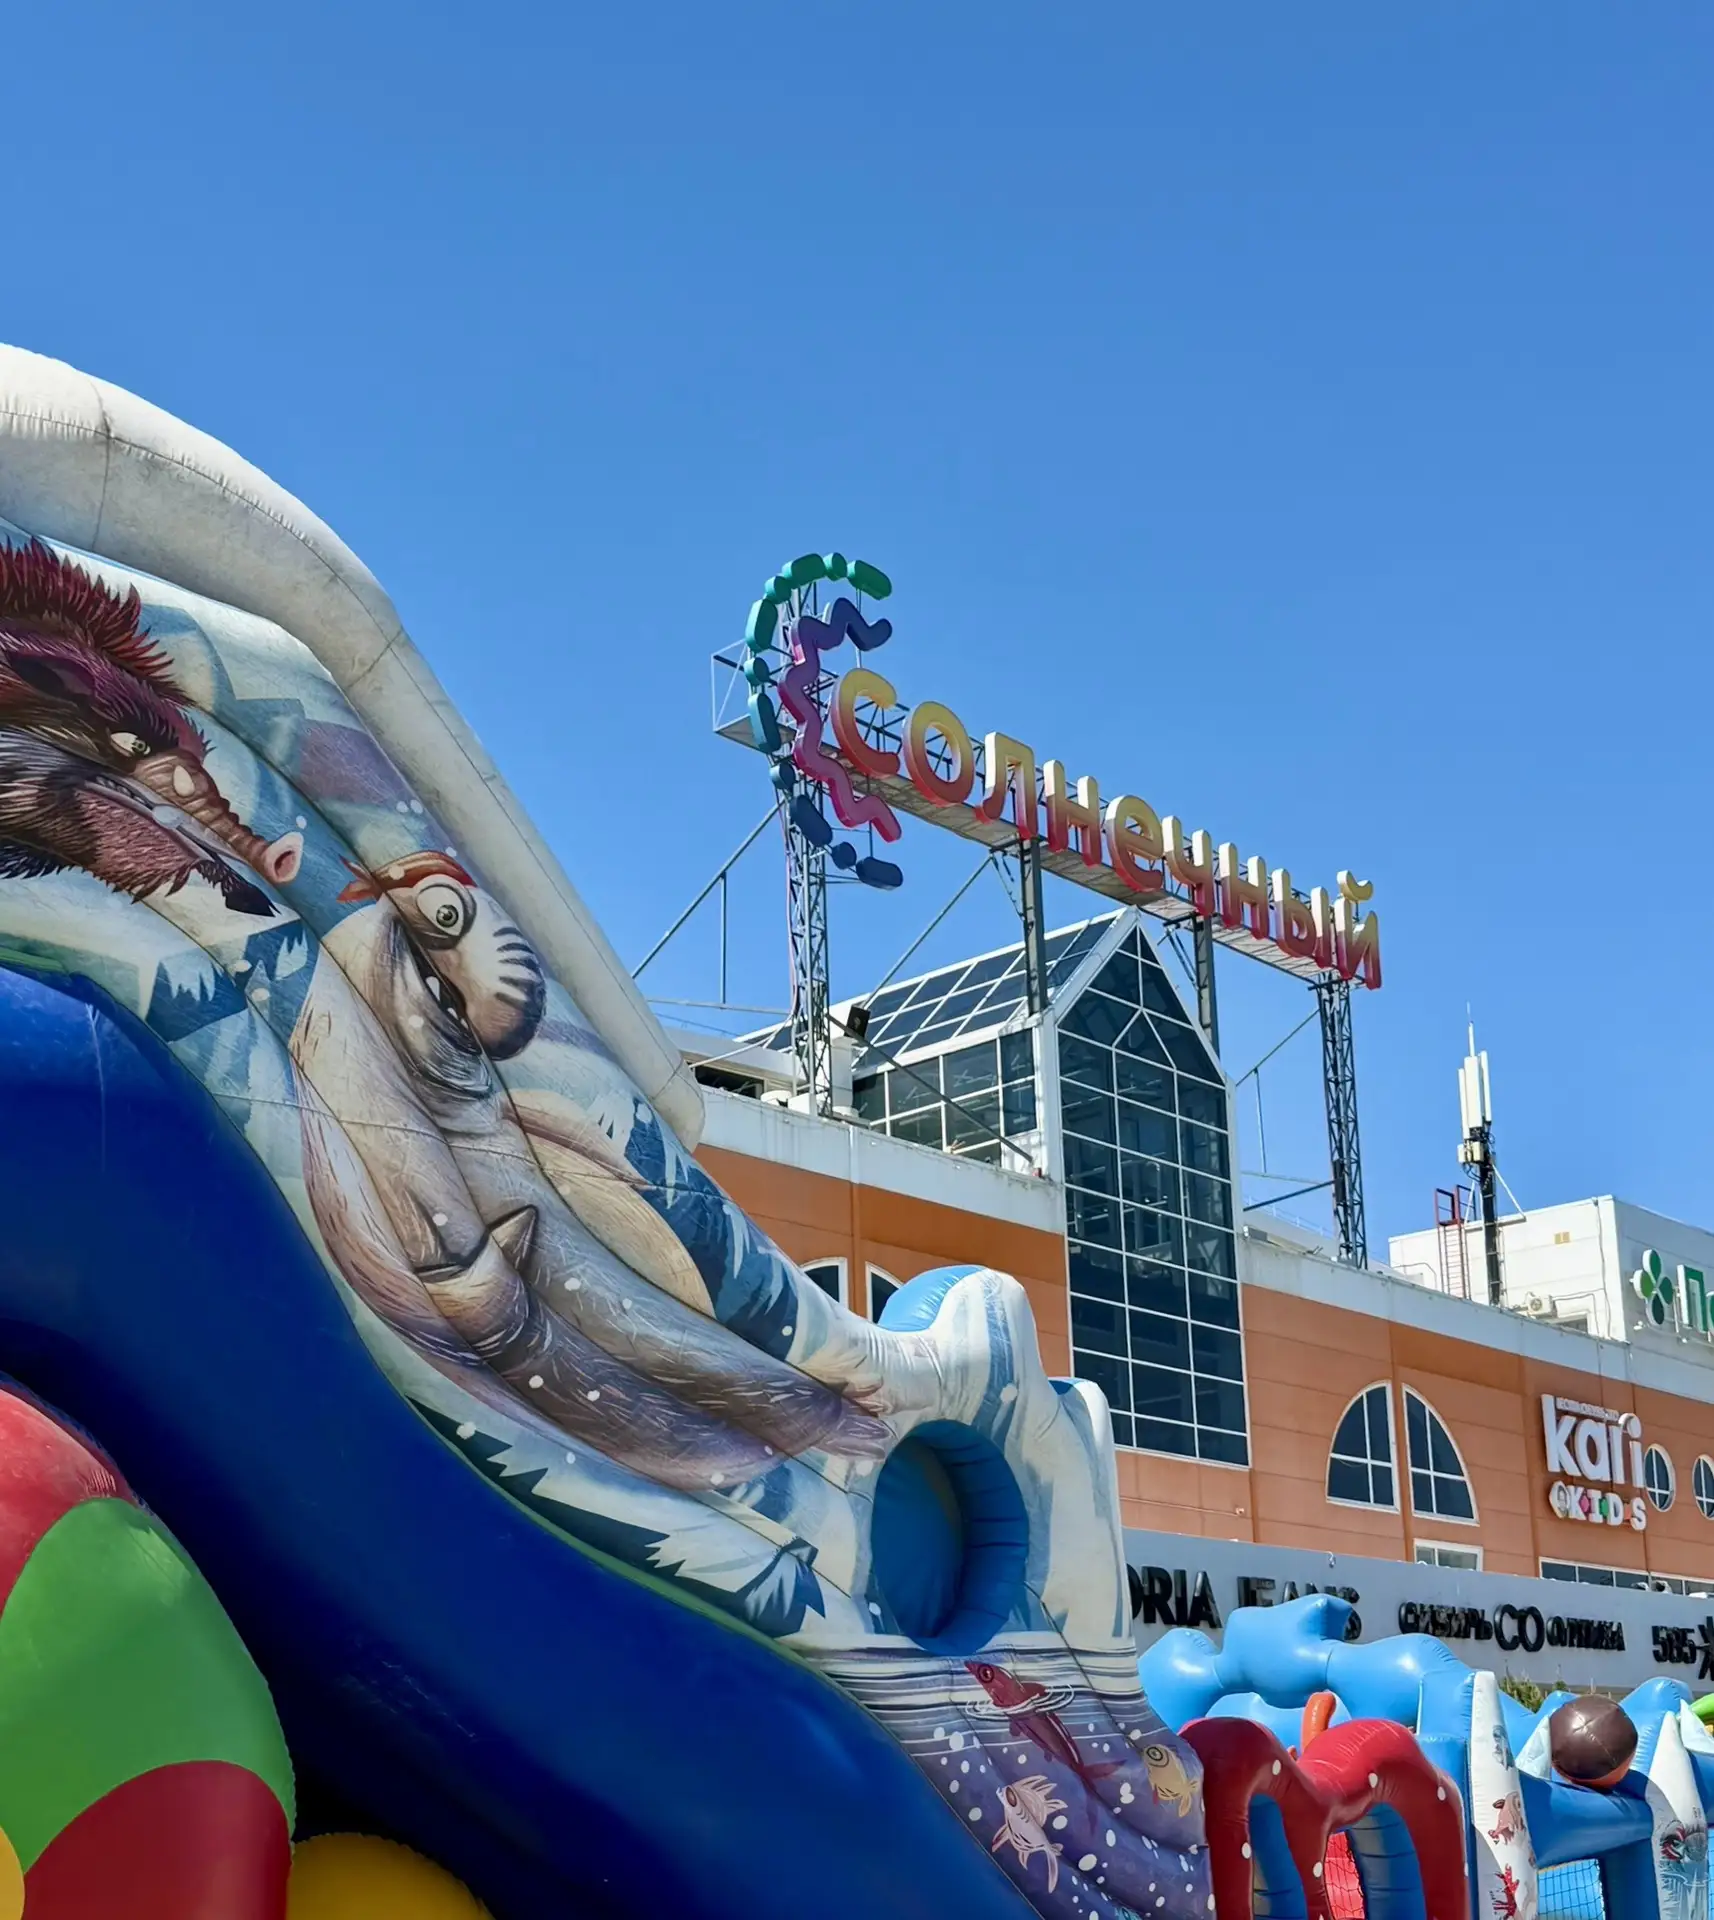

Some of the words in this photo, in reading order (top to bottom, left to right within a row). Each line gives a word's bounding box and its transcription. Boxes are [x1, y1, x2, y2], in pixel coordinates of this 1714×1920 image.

[1541, 1393, 1644, 1488] kari
[1567, 1484, 1646, 1531] KIDS
[1652, 1625, 1697, 1664] 585
